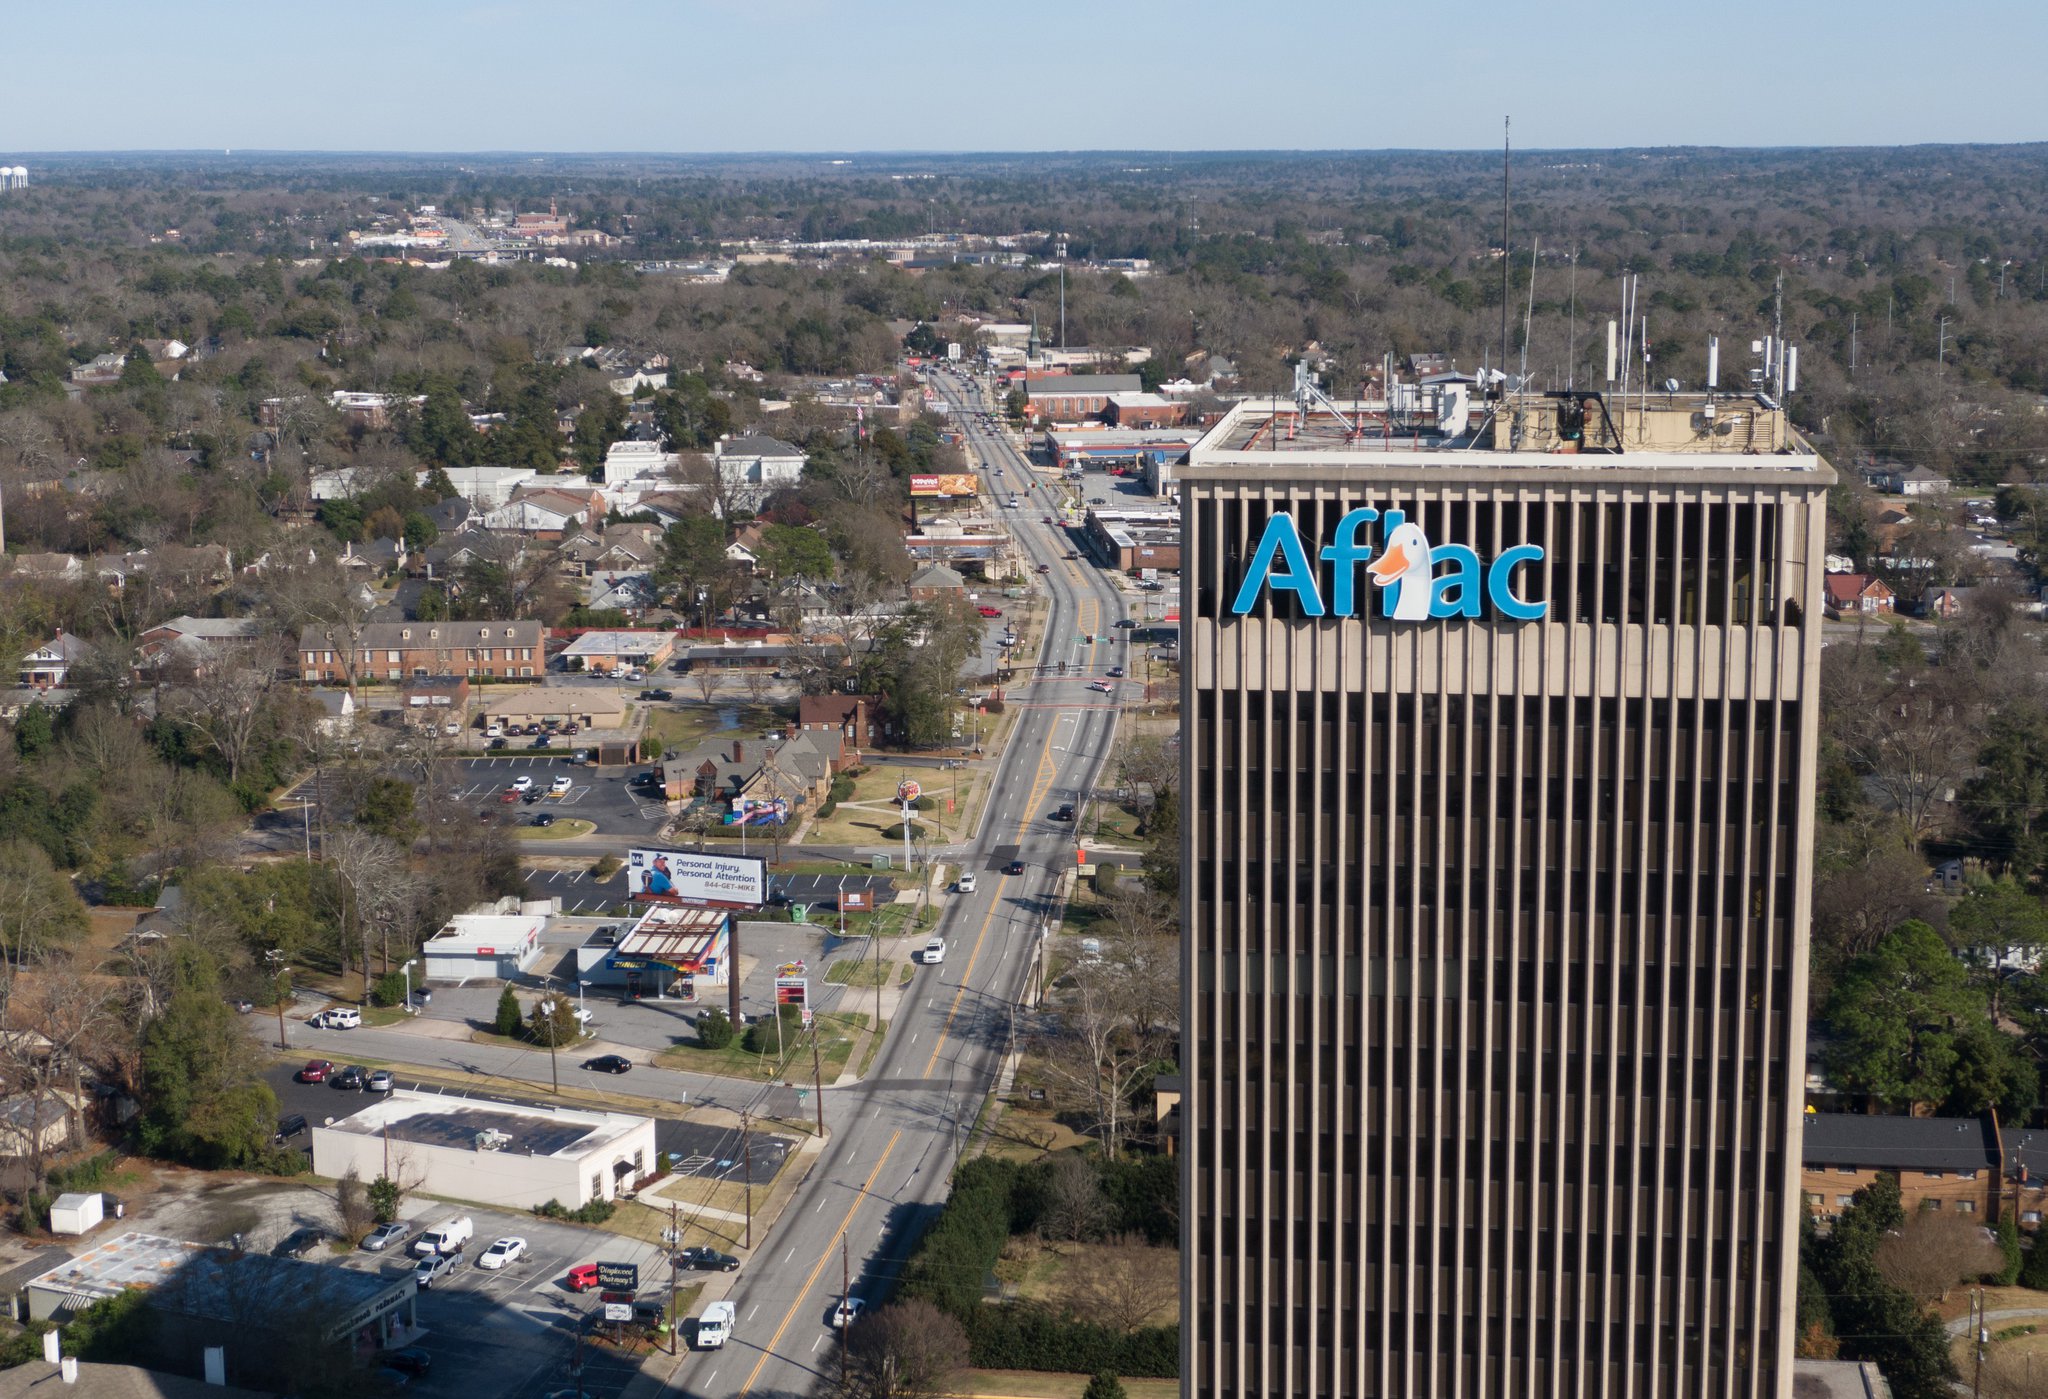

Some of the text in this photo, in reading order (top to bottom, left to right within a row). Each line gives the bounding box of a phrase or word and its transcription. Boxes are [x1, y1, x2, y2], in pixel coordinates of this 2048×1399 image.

[1232, 507, 1548, 618] Aflac
[632, 855, 643, 865] MH
[676, 859, 740, 872] Personal Injury.
[676, 868, 713, 879] Personal
[704, 881, 756, 892] 844-GET-MIKE
[613, 961, 647, 969] SUNOCO
